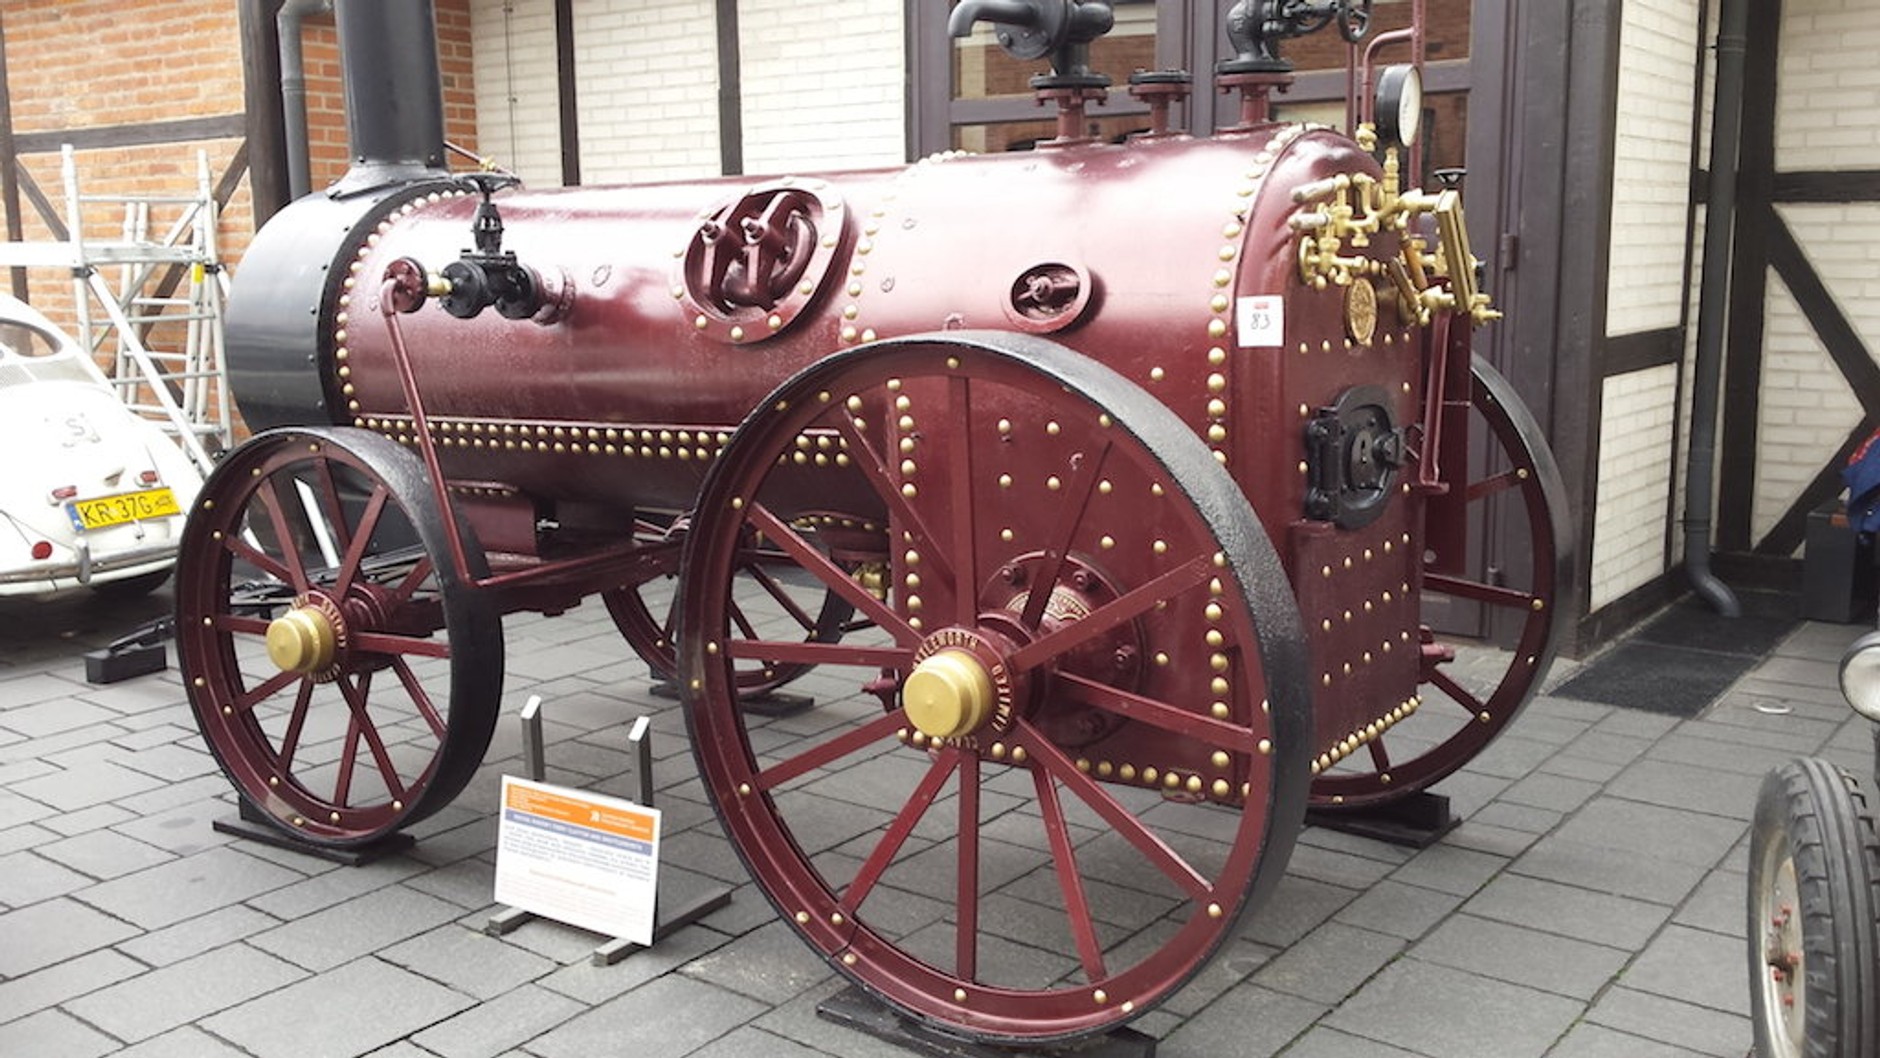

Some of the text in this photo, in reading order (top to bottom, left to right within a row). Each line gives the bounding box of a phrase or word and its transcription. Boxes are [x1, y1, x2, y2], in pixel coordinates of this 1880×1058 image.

[1250, 312, 1271, 330] 83
[80, 495, 153, 526] KR 37G
